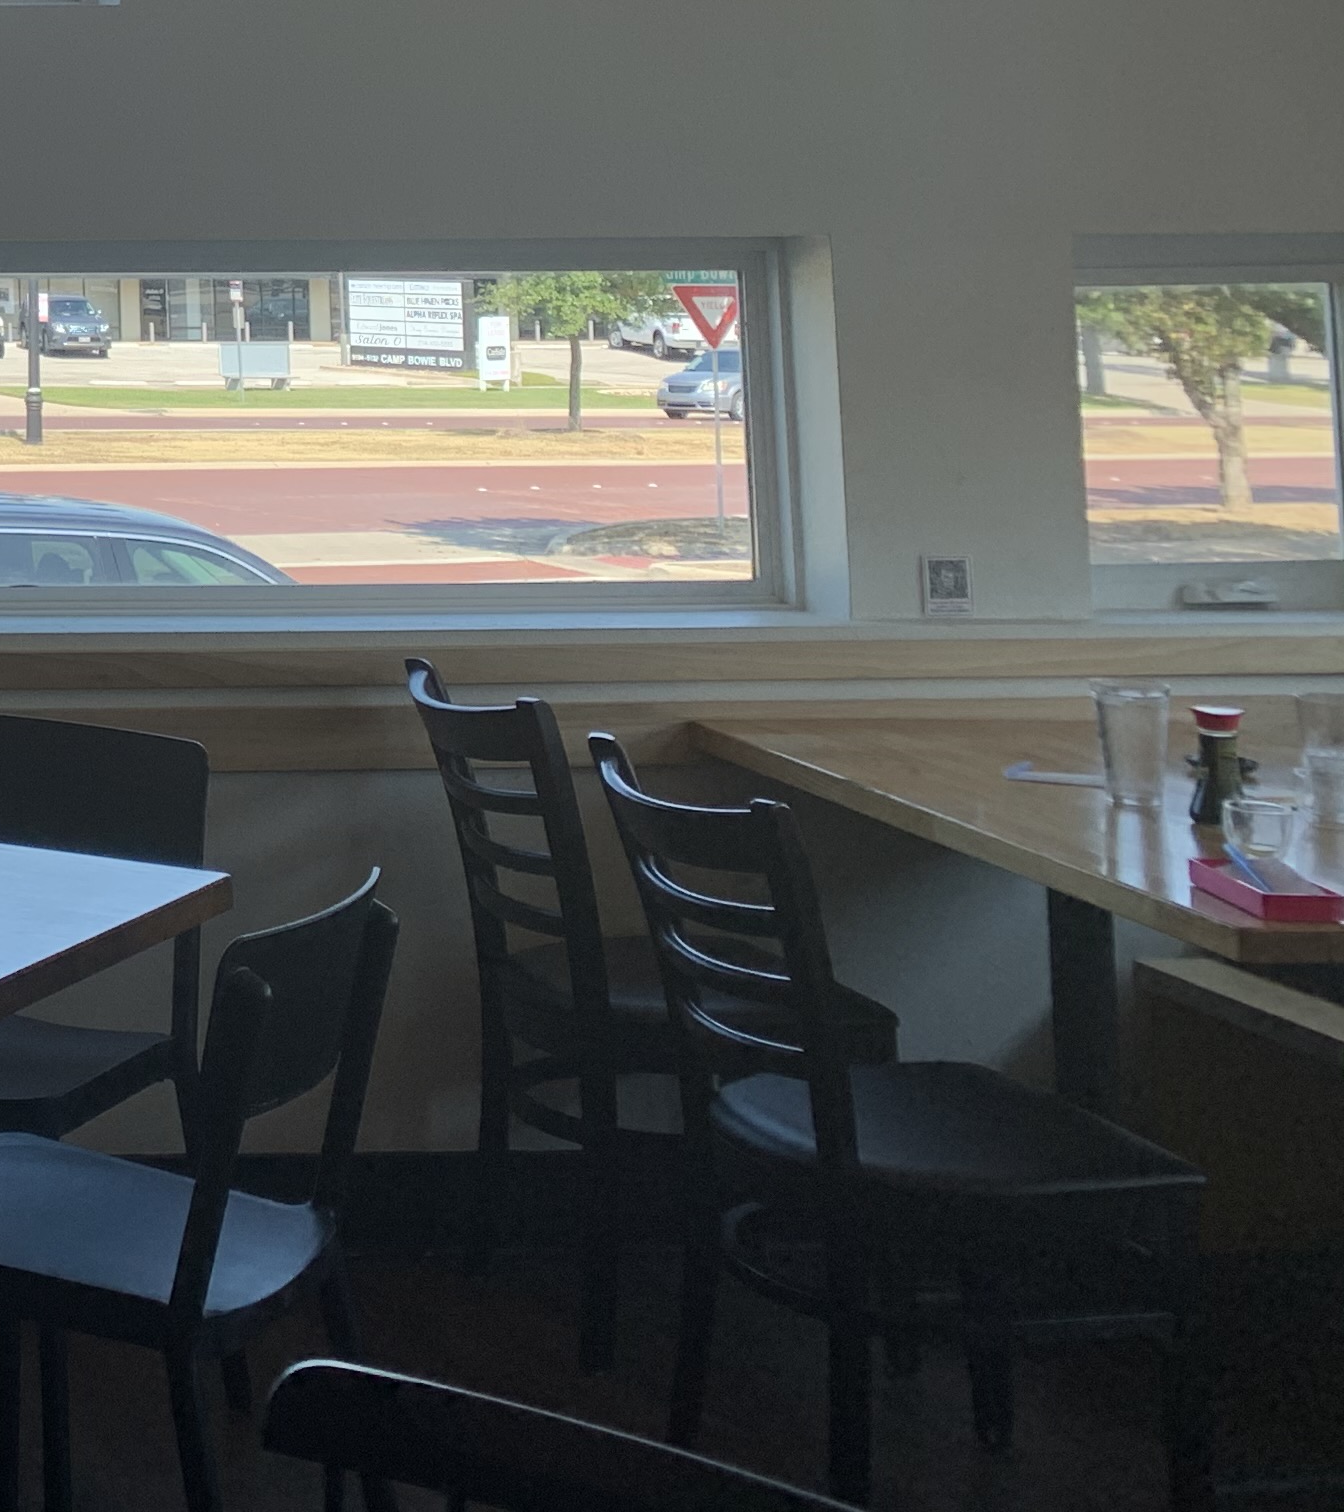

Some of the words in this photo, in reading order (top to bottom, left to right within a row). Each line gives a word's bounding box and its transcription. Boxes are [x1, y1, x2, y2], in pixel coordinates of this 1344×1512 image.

[355, 334, 390, 345] Salon
[380, 354, 406, 365] CAMP
[407, 355, 437, 366] BOWIE
[439, 357, 463, 367] BLVD
